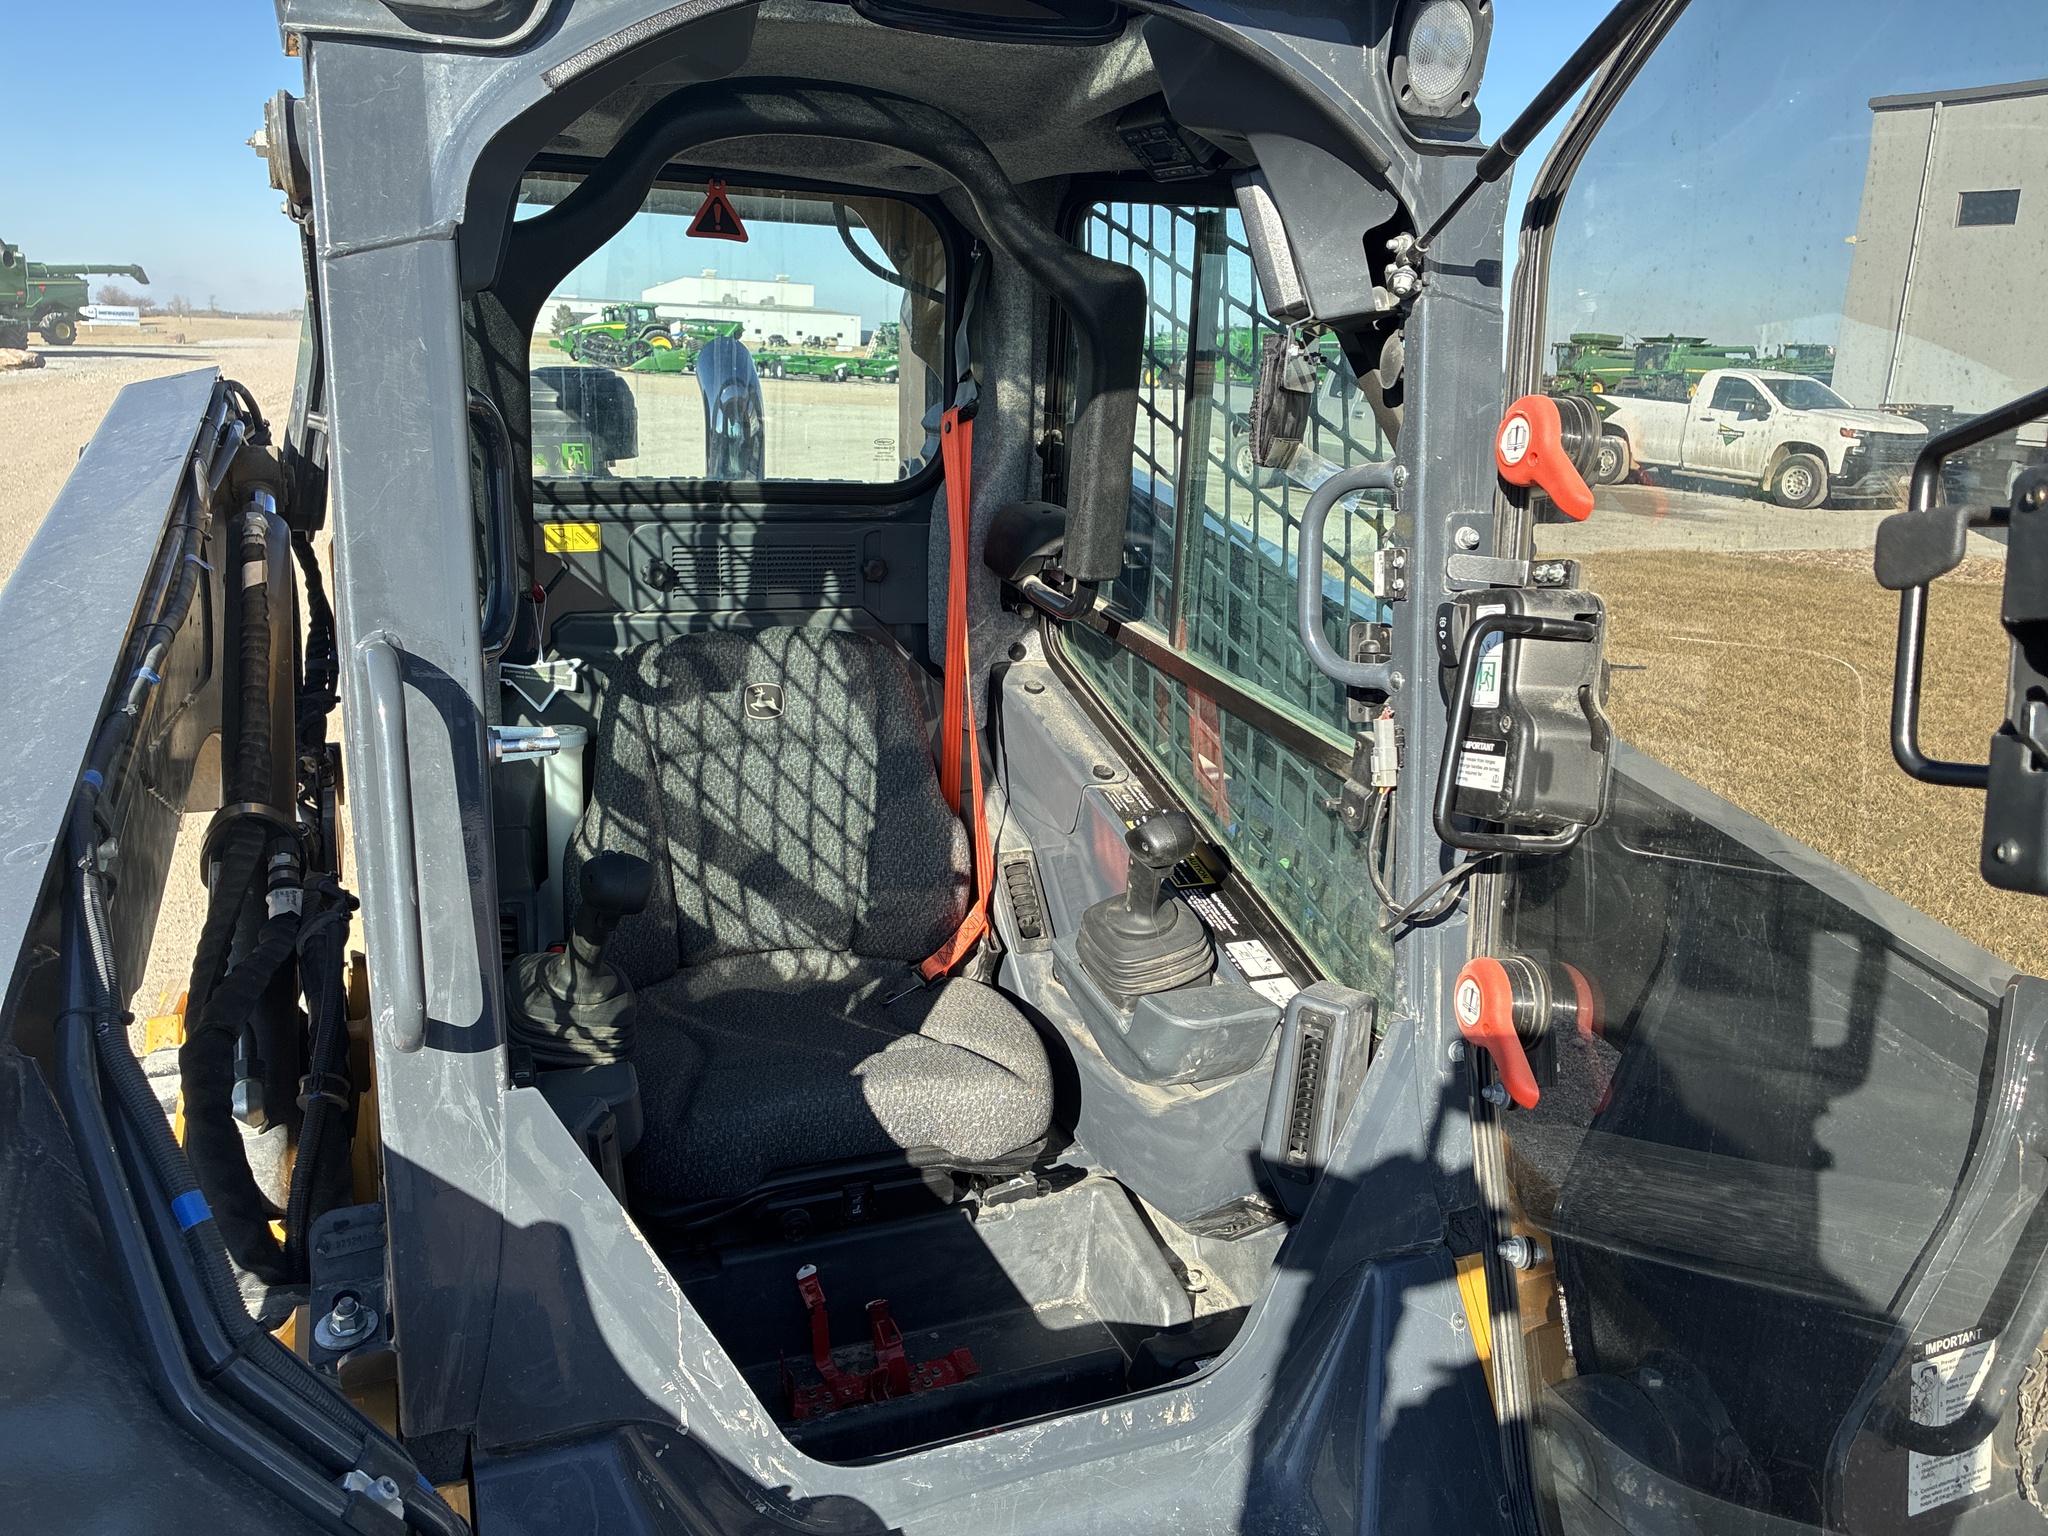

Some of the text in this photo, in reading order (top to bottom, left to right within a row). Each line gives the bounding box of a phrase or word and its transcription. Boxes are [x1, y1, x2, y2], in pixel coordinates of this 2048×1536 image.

[1187, 857, 1209, 879] AUTION
[1210, 892, 1239, 925] IMPORTANT
[1925, 1328, 1982, 1355] IMPORTANT
[1941, 1357, 1956, 1365] Prevent
